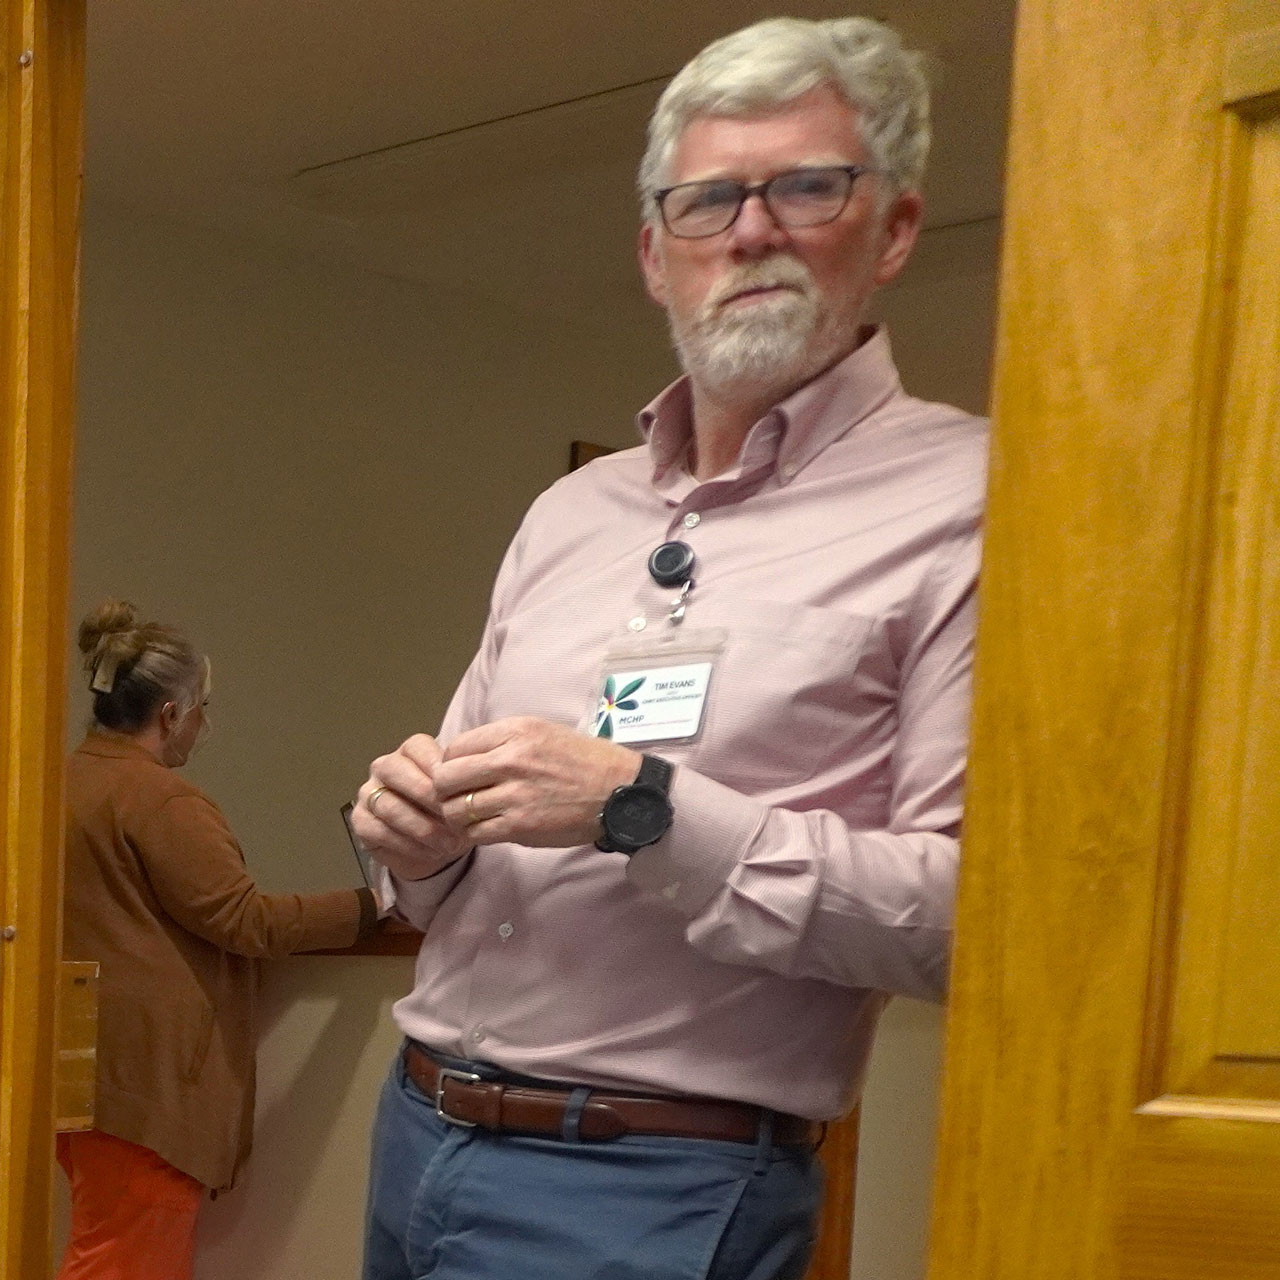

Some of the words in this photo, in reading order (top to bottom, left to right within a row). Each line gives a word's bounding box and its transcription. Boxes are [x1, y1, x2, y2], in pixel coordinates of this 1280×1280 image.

[655, 682, 668, 691] TIM
[669, 679, 696, 689] EVANS
[619, 715, 644, 724] MCHP
